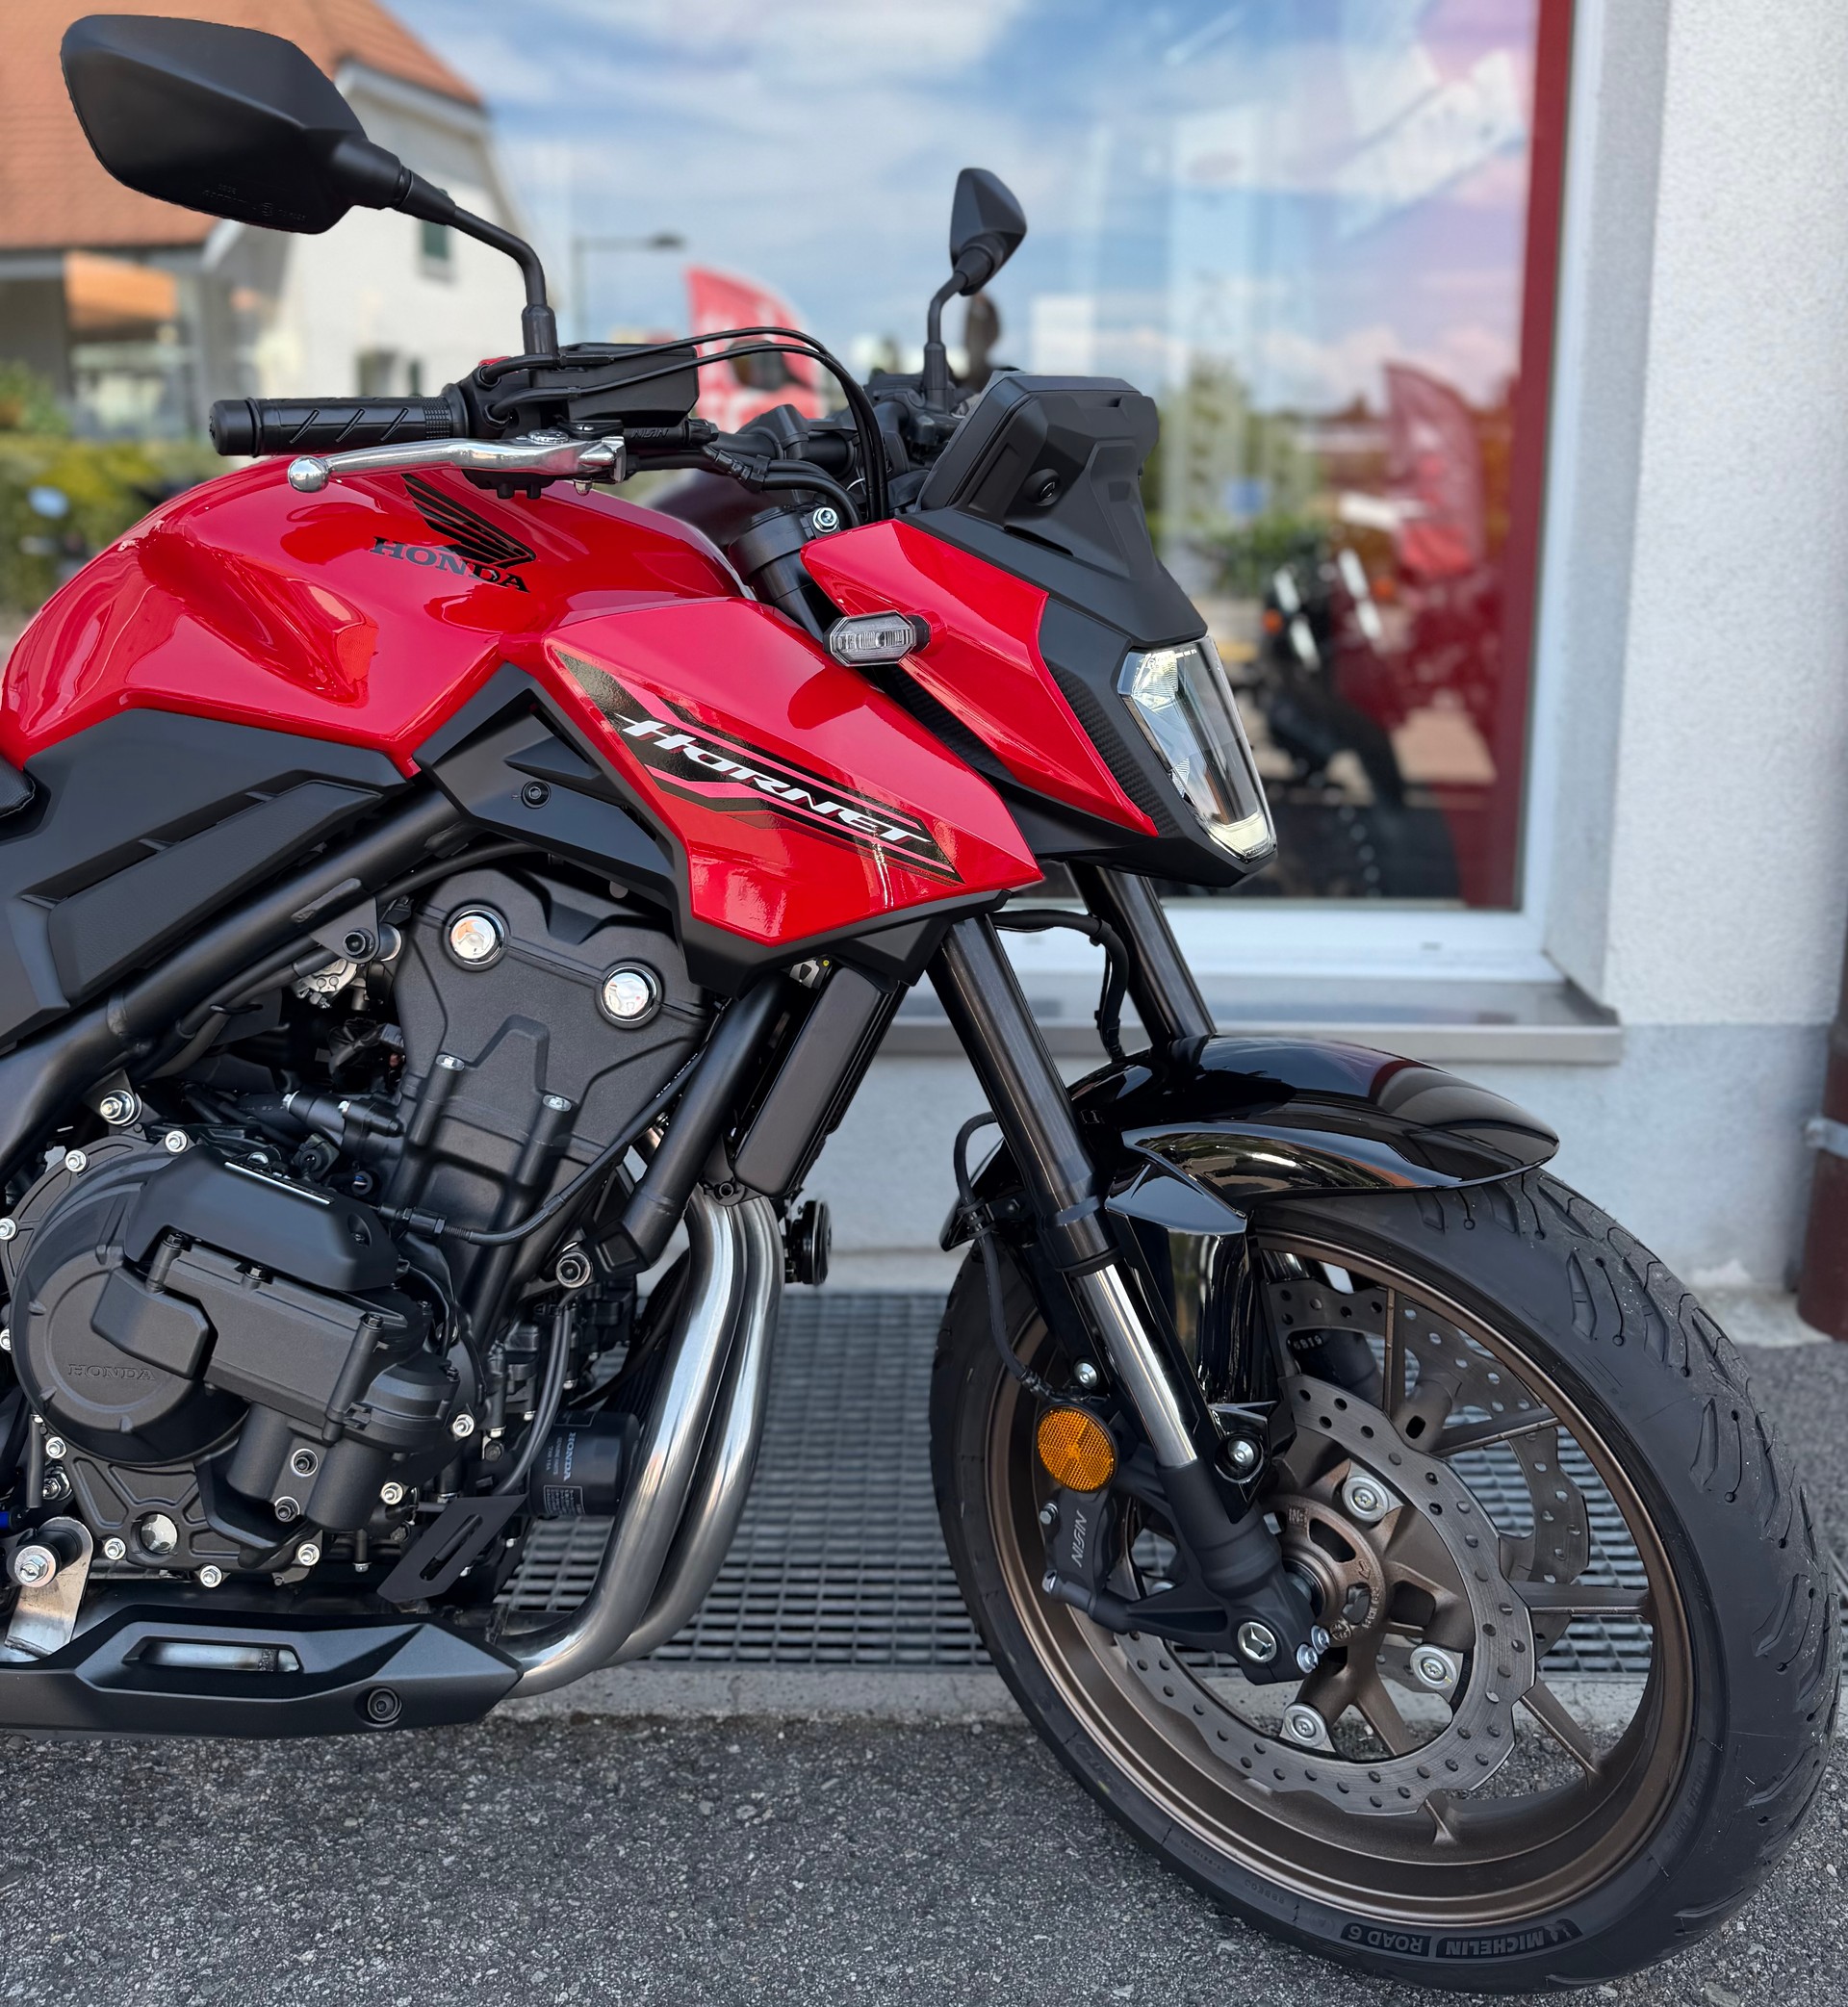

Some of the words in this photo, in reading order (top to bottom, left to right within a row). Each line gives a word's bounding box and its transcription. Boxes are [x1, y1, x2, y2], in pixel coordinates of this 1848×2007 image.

[370, 536, 530, 593] HONDA
[614, 713, 931, 844] HORNET
[67, 1363, 155, 1380] HONDA
[563, 1431, 577, 1481] HONDA
[1348, 1924, 1362, 1941] 6
[1368, 1930, 1424, 1953] ROAD
[1445, 1929, 1545, 1955] MICHELIN
